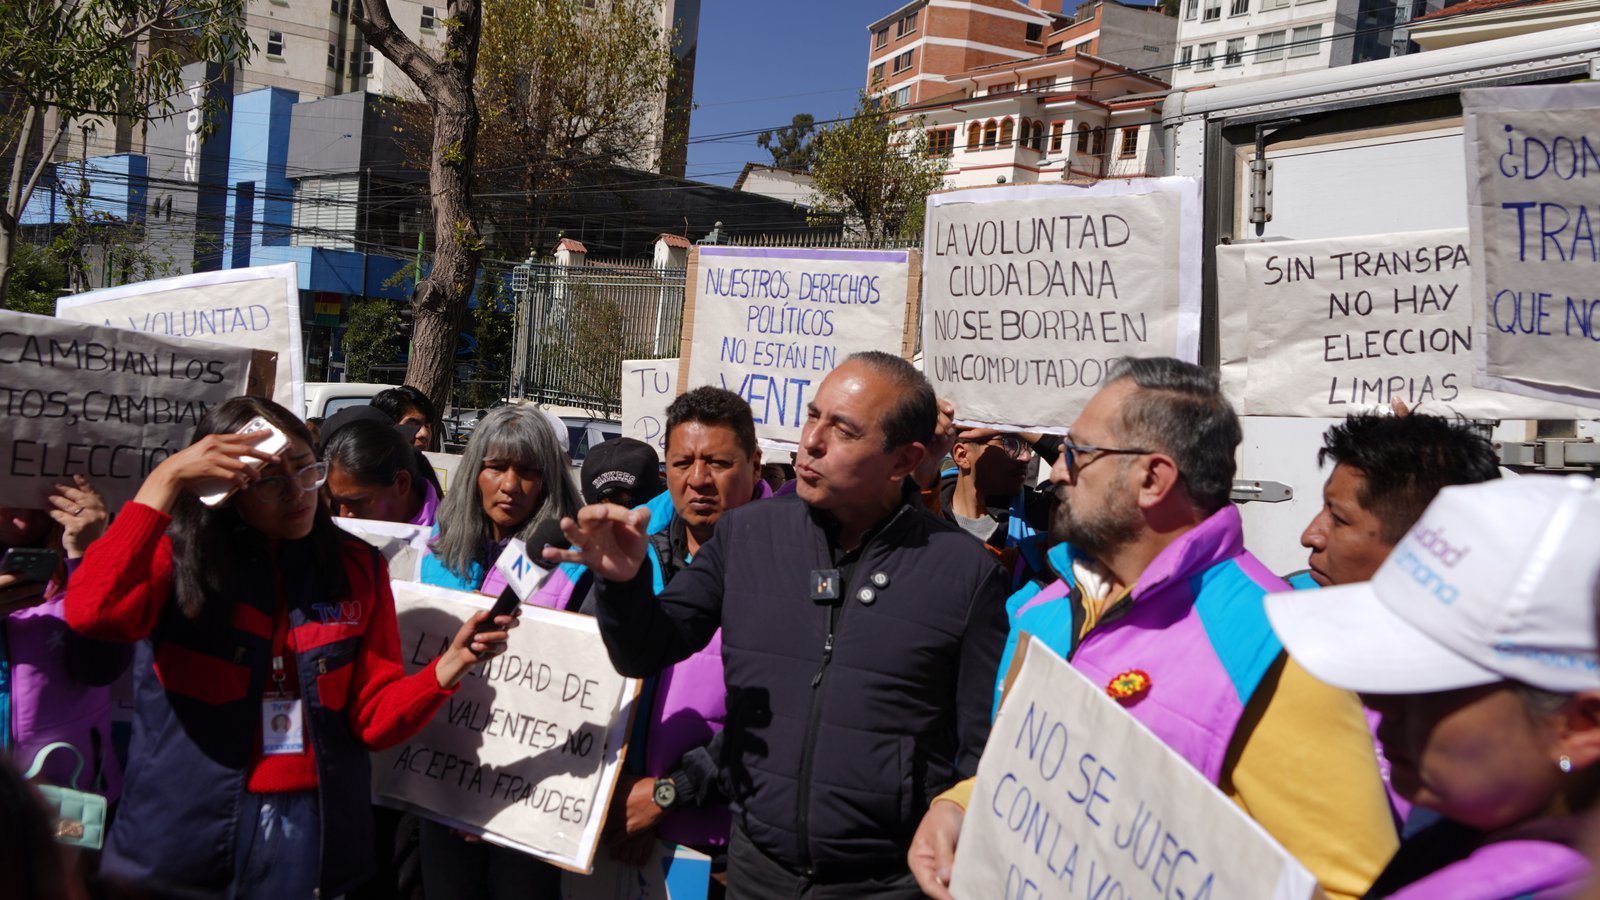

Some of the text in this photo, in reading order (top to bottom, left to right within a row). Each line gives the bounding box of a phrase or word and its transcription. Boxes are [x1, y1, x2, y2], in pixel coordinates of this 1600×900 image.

[184, 80, 200, 182] 2504
[963, 213, 1131, 257] VOLUNTAD
[1501, 202, 1600, 263] TRA
[949, 259, 1119, 300] CIUDADANA
[1264, 243, 1471, 285] SIN TRANSPA
[705, 267, 881, 305] NUESTROS DERECHOS
[1328, 284, 1459, 320] NO HAY
[746, 302, 835, 337] POLÍTICOS
[1493, 288, 1552, 336] QUE
[720, 335, 837, 371] NO ESTÁN EN
[1323, 325, 1473, 363] ELECCION
[169, 352, 225, 385] LOS
[630, 367, 670, 398] TU
[1327, 372, 1460, 406] LIMPIAS
[10, 437, 180, 480] ELECCIÓ
[591, 470, 636, 489] YANKEES
[468, 654, 552, 693] IUDAD
[561, 672, 600, 711] DE
[447, 697, 595, 757] VALIENTES NO
[393, 745, 586, 825] ACEPTA FRAUDES
[1014, 700, 1069, 782] NO
[1067, 752, 1117, 828] SE
[991, 772, 1050, 856] CON
[1045, 823, 1080, 893] LA
